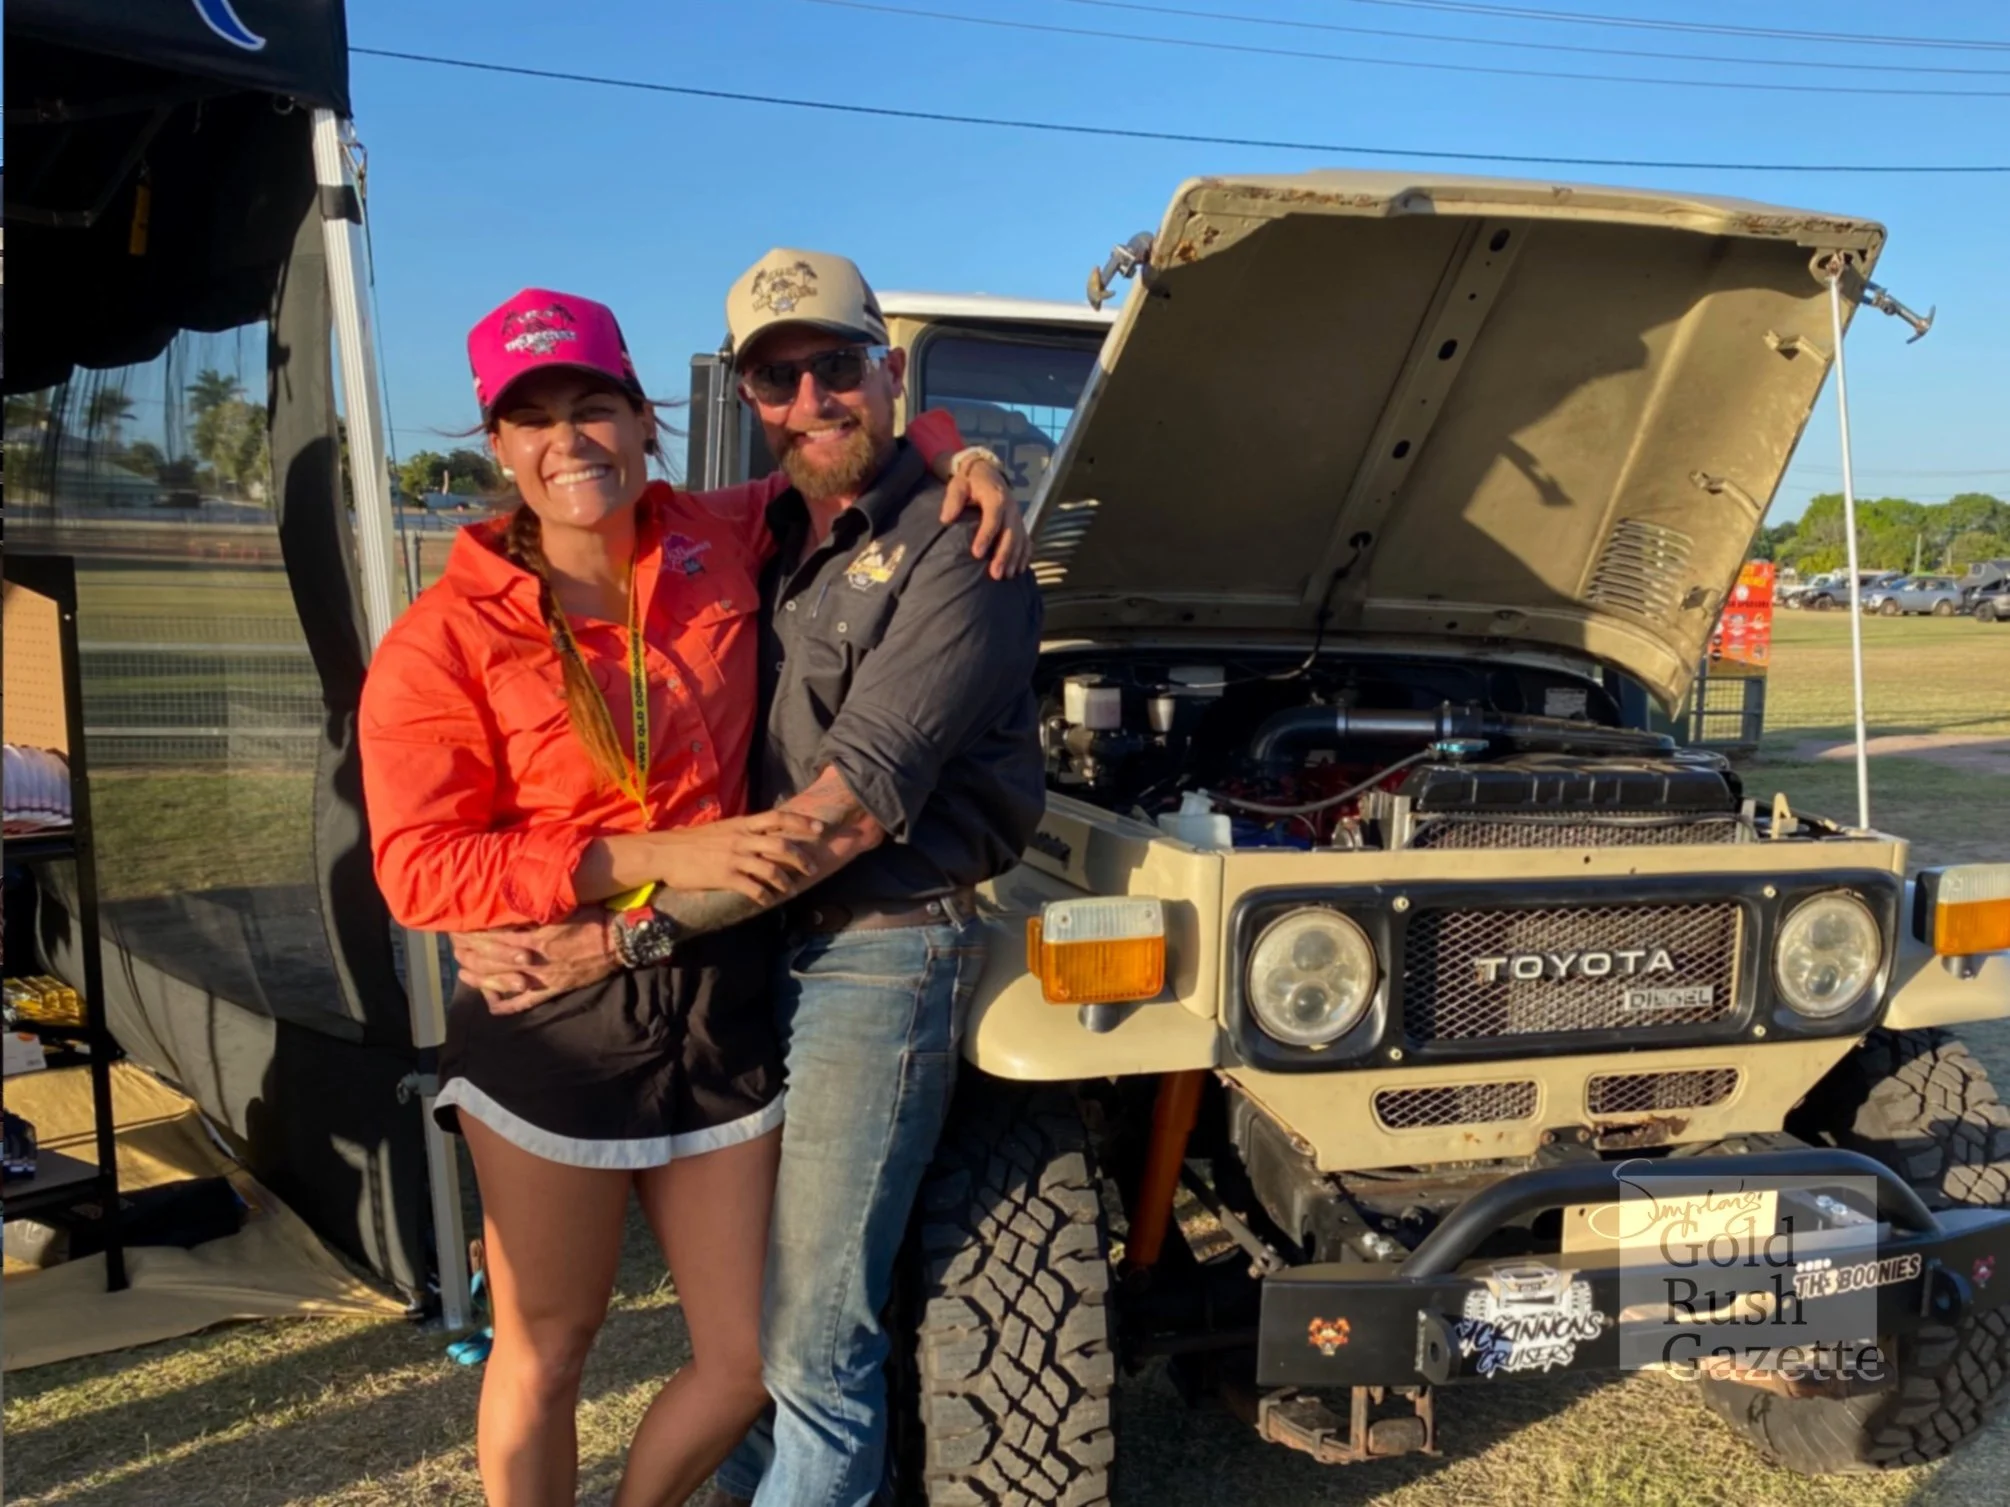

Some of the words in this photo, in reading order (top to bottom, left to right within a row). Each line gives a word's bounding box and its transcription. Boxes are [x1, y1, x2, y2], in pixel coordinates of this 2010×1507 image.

[636, 710, 646, 737] QLD
[1477, 950, 1675, 982] TOYOTA
[1838, 1256, 1920, 1292] BOONIES
[1477, 1344, 1575, 1374] CRUISERS
